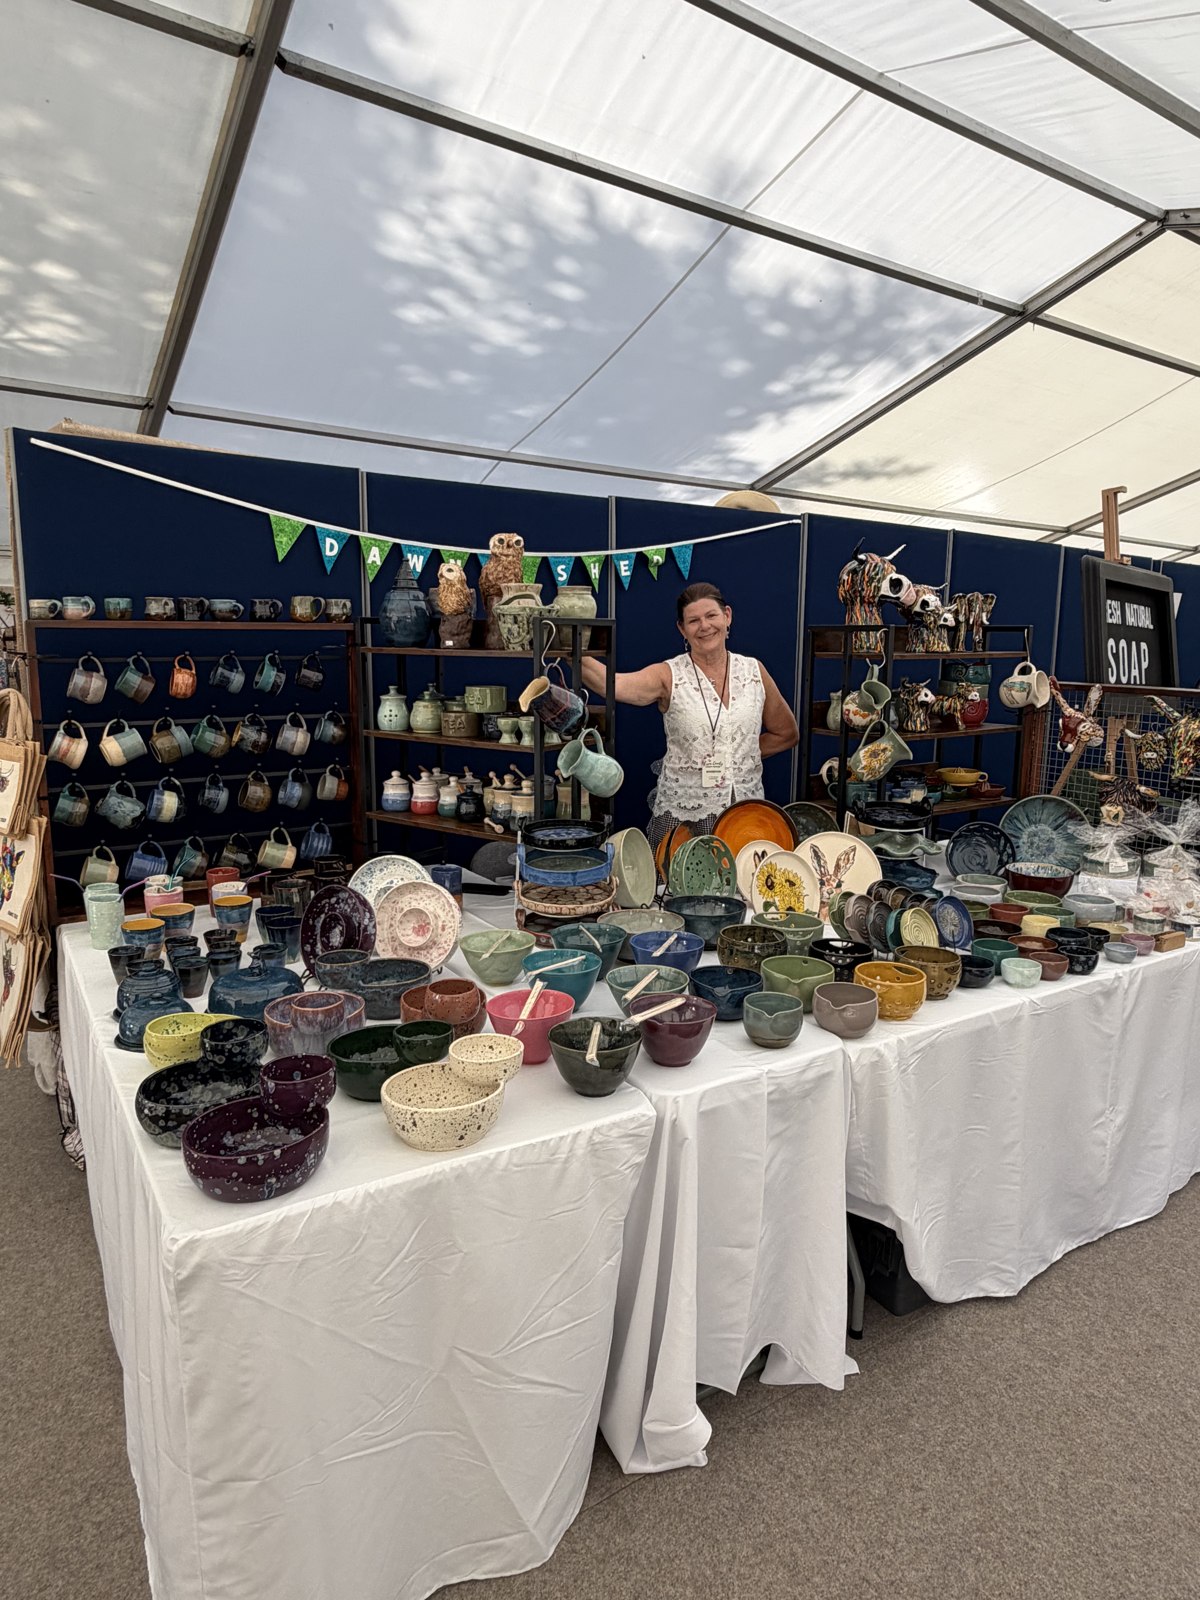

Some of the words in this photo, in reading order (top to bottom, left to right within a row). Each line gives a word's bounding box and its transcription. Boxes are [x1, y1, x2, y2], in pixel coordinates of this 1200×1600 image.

[1106, 599, 1122, 625] ESH
[1125, 602, 1154, 630] NATURAL
[1107, 637, 1149, 685] SOAP
